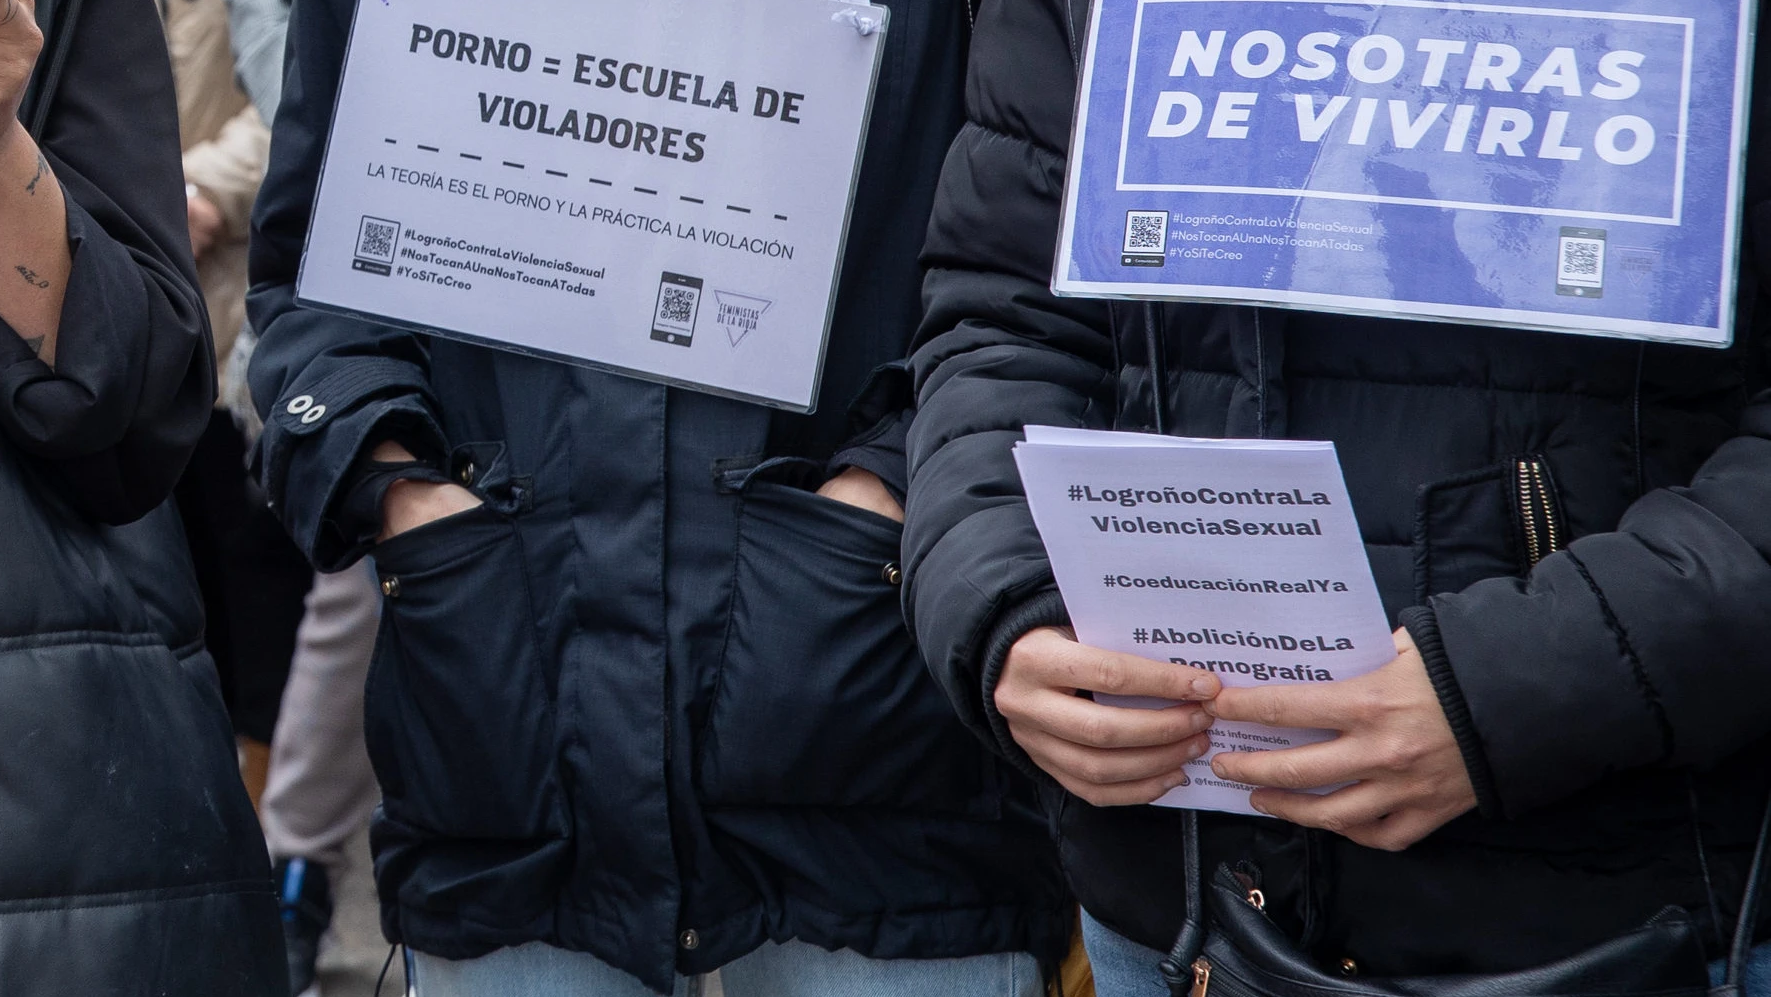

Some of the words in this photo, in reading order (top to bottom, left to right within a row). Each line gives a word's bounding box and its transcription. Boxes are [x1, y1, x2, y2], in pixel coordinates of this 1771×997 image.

[408, 23, 532, 74] PORNO
[541, 57, 561, 76] =
[573, 53, 739, 113] ESCUELA
[752, 85, 806, 125] DE
[1168, 28, 1647, 102] NOSOTRAS
[477, 92, 707, 164] VIOLADORES
[1146, 90, 1259, 140] DE
[1295, 94, 1657, 167] VIVIRLO
[366, 162, 386, 179] LA
[389, 166, 444, 192] TEORÍA
[448, 178, 469, 196] ES
[472, 182, 490, 200] EL
[493, 186, 552, 212] PORNO
[555, 198, 567, 215] Y
[568, 202, 588, 221] LA
[590, 203, 673, 237] PRÁCTICA
[675, 221, 697, 240] LA
[701, 226, 795, 261] VIOLACIÓN
[1173, 212, 1374, 235] #LogroñoContraLaViolenciaSexual
[1171, 230, 1364, 252] #NosTocanAUnaNosTocanATodas
[404, 228, 606, 280] #LogroñoContraLaViolenciaSexual
[400, 247, 596, 297] #NosTocanAUnaNosTocanATodas
[717, 313, 725, 324] DE
[728, 315, 736, 325] LA
[738, 317, 757, 330] RIOJA
[719, 303, 759, 320] FEMINISTAS
[1068, 484, 1332, 507] #LogroñoContraLa
[1091, 516, 1322, 536] ViolenciaSexual
[1103, 574, 1349, 594] #CoeducaciónRealYa
[1133, 628, 1355, 652] #AboliciónDeLa
[1227, 730, 1291, 746] información
